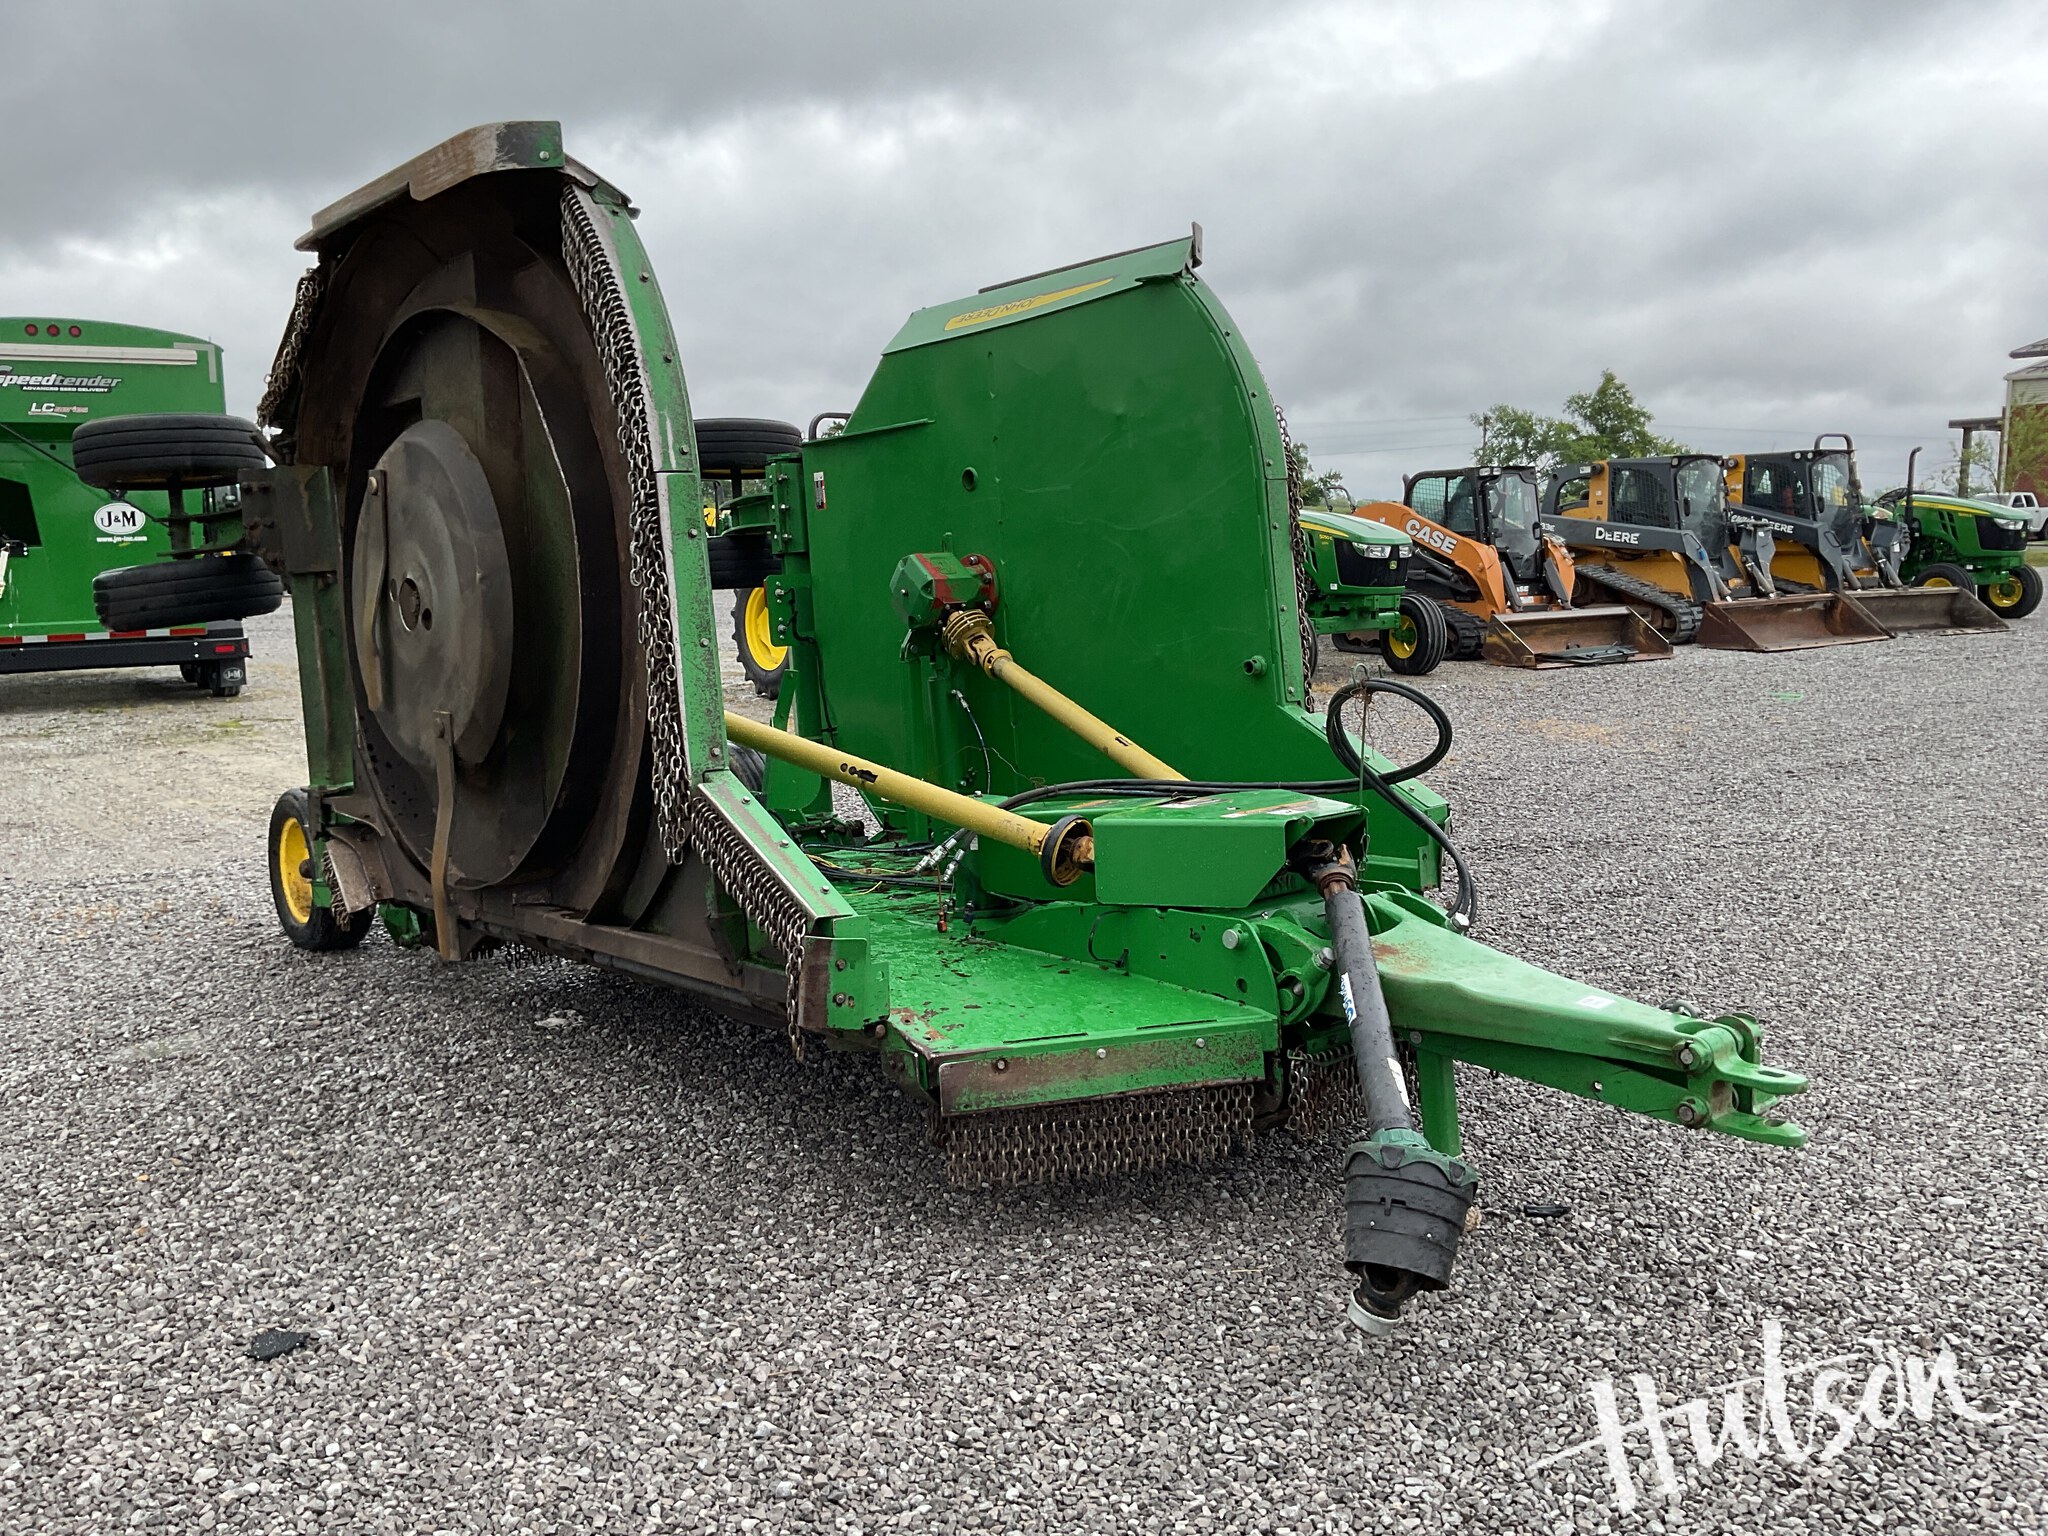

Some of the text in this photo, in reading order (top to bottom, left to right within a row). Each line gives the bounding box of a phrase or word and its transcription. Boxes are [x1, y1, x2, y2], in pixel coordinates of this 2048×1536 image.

[957, 297, 1035, 322] JOHN DEERE
[100, 511, 137, 527] J&M
[1405, 519, 1458, 555] CASE
[1595, 527, 1641, 545] DEERE
